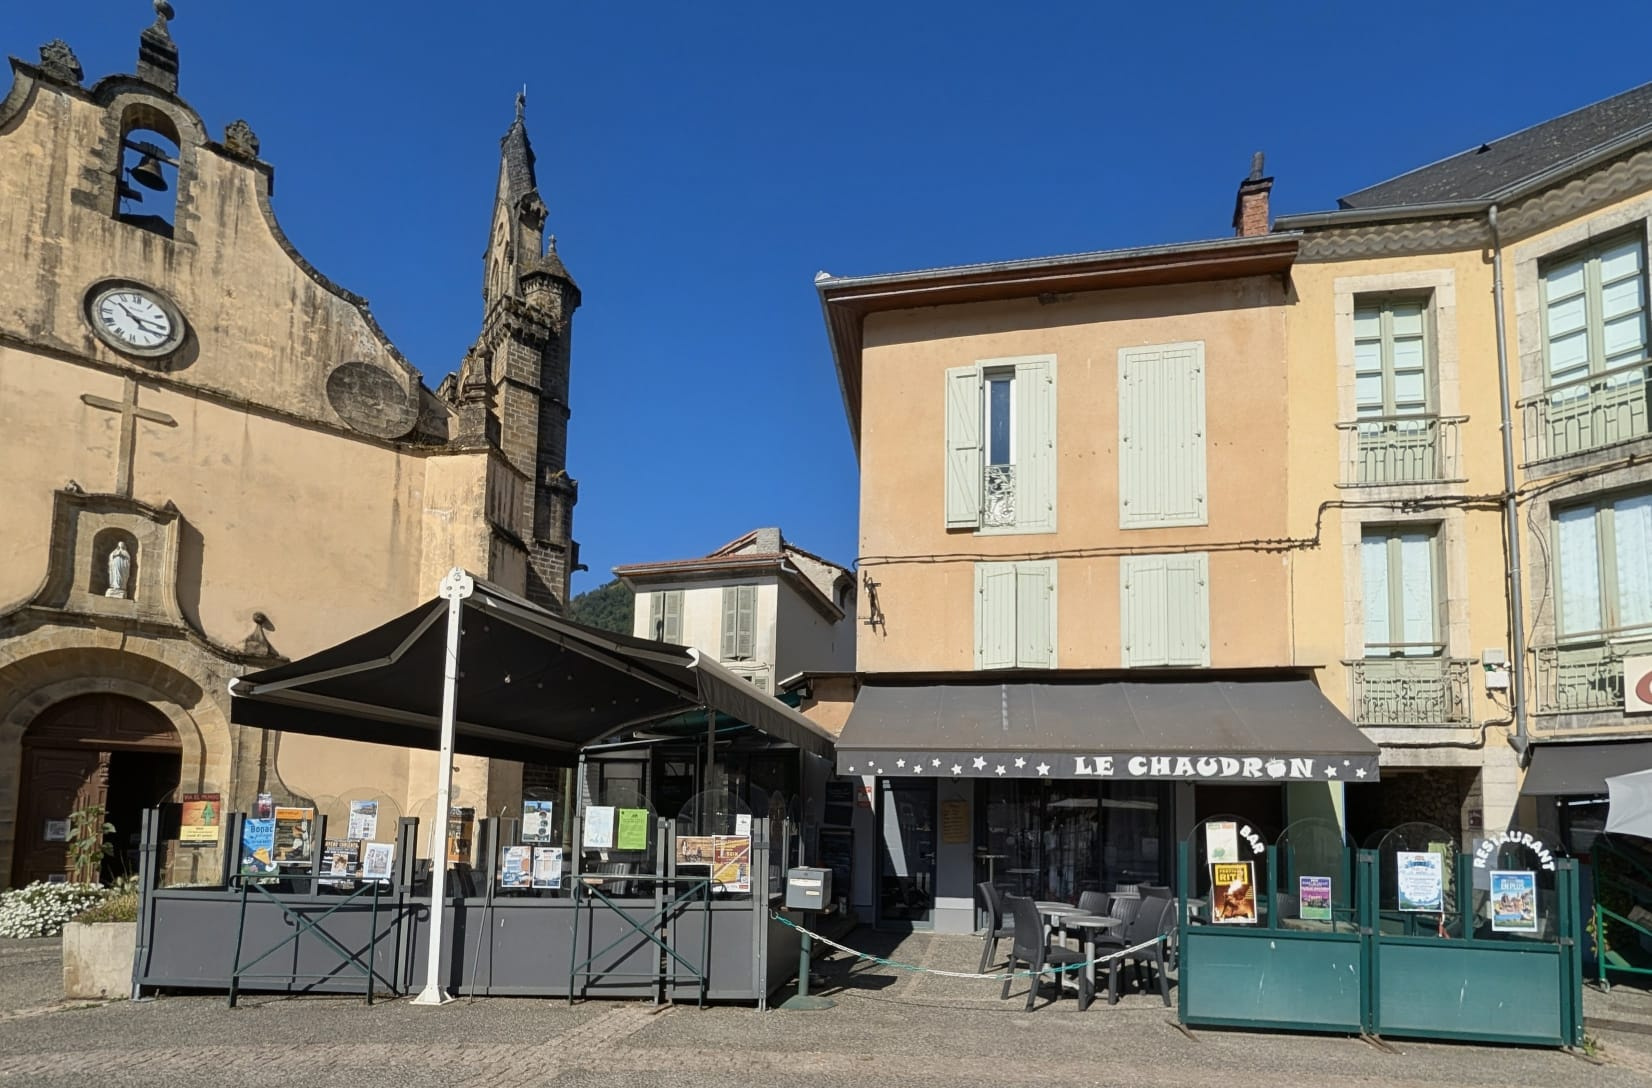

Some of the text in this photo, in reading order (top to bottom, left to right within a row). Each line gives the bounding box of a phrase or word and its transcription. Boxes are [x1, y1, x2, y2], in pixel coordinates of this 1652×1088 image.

[1073, 755, 1315, 779] LE CHAUDRON
[1240, 825, 1265, 855] BAR
[1473, 830, 1556, 872] RESTAURANT
